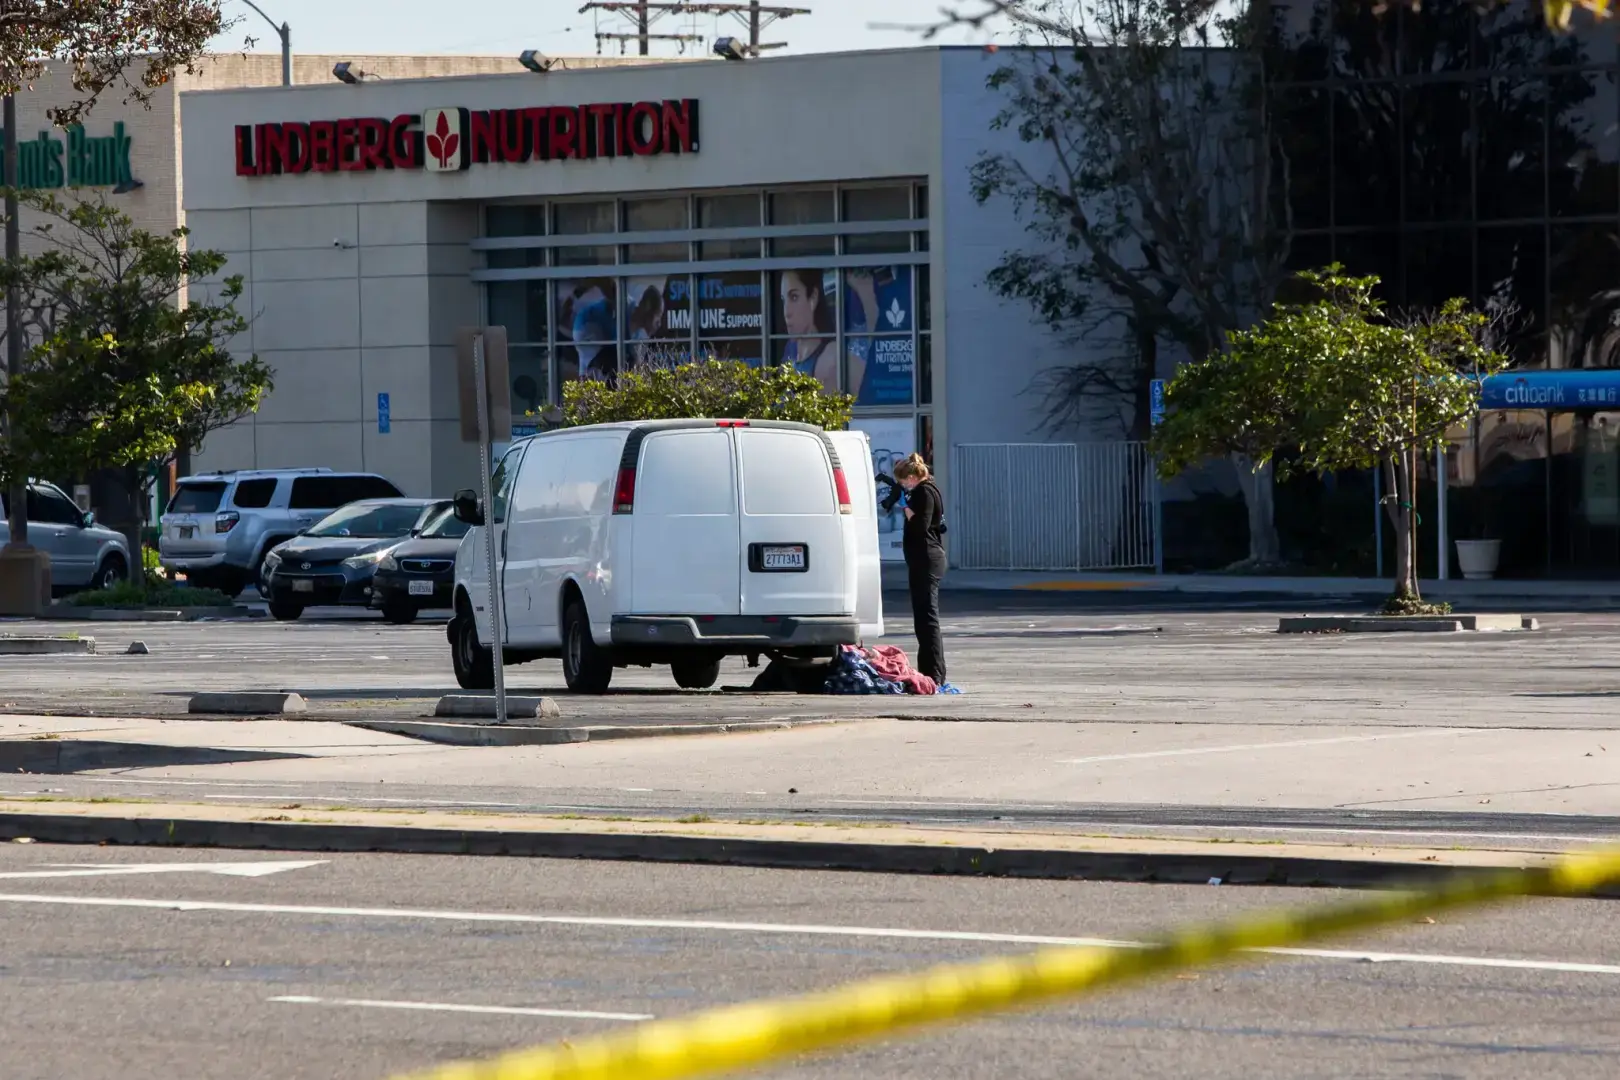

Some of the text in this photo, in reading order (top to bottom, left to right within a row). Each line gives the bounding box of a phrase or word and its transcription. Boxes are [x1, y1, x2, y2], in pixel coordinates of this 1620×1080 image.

[234, 98, 700, 176] LINDBERG NUTRITION
[66, 120, 133, 187] Bank
[667, 308, 762, 329] IMMUNE SUPPORT
[876, 340, 913, 351] LINDBERG
[876, 352, 912, 363] NUTRITION
[1505, 381, 1565, 403] citibank
[766, 553, 801, 565] 27773A1
